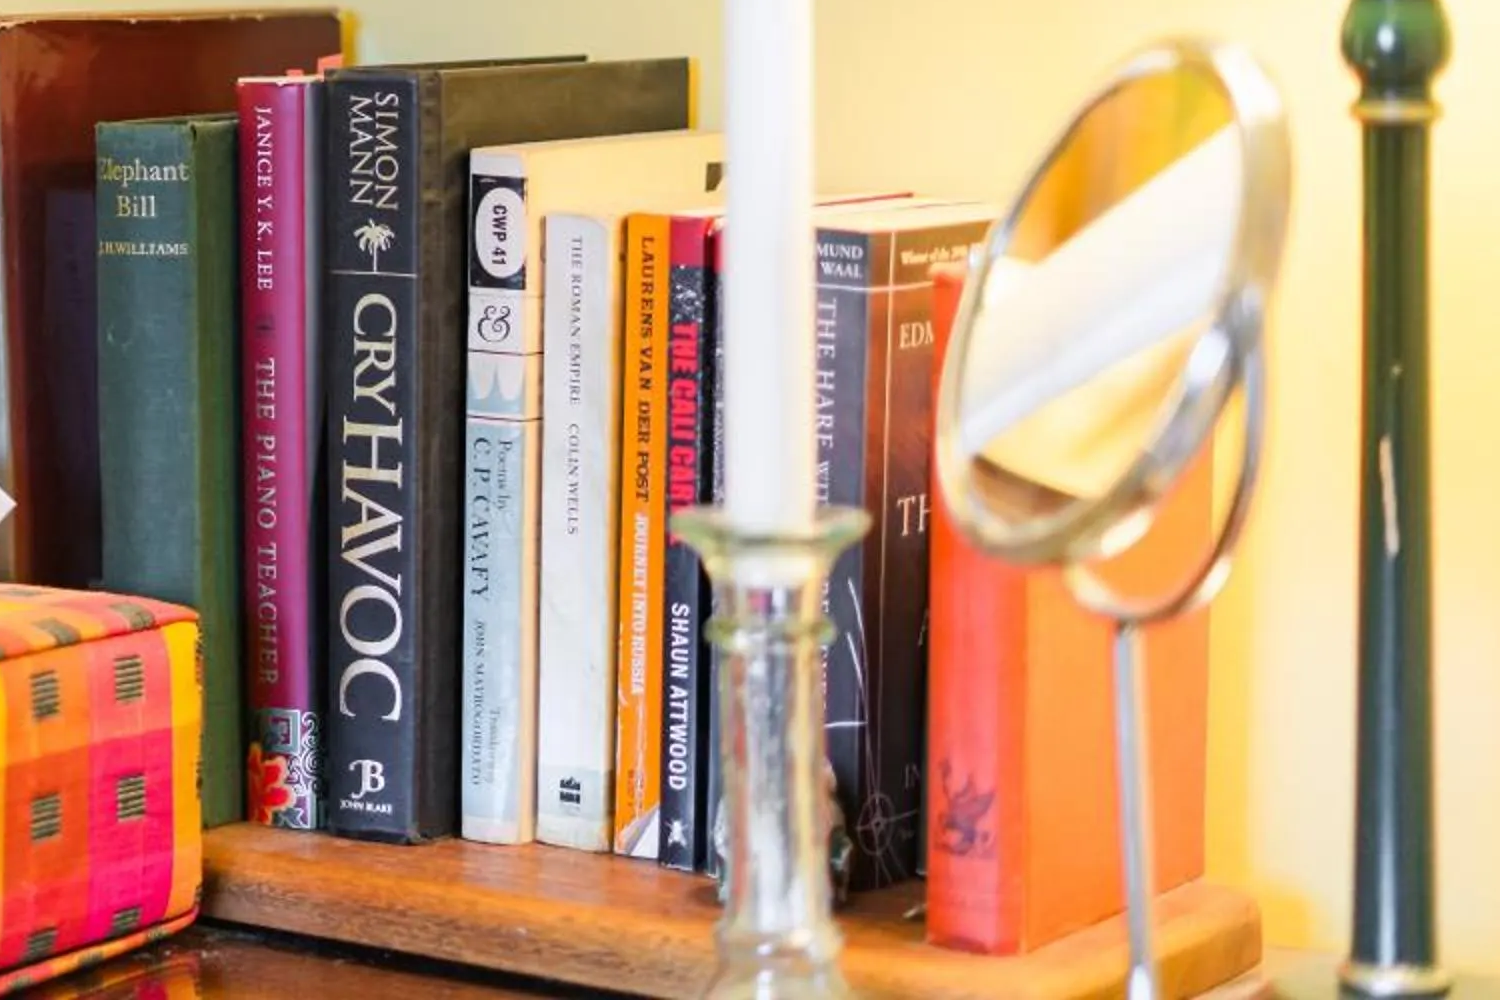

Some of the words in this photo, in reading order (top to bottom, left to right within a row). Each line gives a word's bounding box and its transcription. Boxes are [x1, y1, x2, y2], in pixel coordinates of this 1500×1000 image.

[100, 157, 189, 188] Elephant
[254, 107, 274, 187] JANICE
[350, 95, 373, 205] MANN
[375, 91, 399, 210] SIMON
[116, 194, 156, 217] Bill
[257, 196, 274, 214] Y.
[491, 205, 508, 242] CWP
[257, 221, 273, 241] K.
[491, 247, 507, 265] 41
[571, 236, 583, 269] THE
[256, 250, 274, 290] LEE
[640, 237, 655, 338] LAURENS
[821, 262, 863, 279] WAAL
[477, 305, 511, 343] &
[570, 277, 583, 336] ROMAN
[816, 298, 837, 358] THE
[352, 294, 398, 415] CRY
[637, 346, 653, 391] VAN
[672, 321, 698, 374] THE
[255, 358, 276, 420] THE
[568, 344, 582, 404] EMPIRE
[636, 401, 651, 448] DER
[671, 378, 697, 440] CALI
[815, 371, 835, 449] HARE
[472, 438, 492, 460] C.
[496, 439, 513, 489] Poems
[567, 423, 580, 473] COLIN
[256, 436, 277, 529] PIANO
[472, 467, 492, 487] P.
[494, 491, 513, 511] by
[634, 454, 650, 501] POST
[566, 480, 579, 535] WELLS
[339, 415, 403, 722] HAVOC
[470, 495, 491, 603] CAVAFY
[633, 513, 648, 586] JOURNEY
[255, 542, 278, 685] TEACHER
[473, 619, 486, 657] JOHN
[632, 593, 647, 633] INTO
[631, 636, 647, 695] RUSSIA
[670, 603, 690, 679] SHAUN
[668, 686, 688, 790] ATTWOOD
[340, 800, 363, 812] JOHN
[366, 801, 393, 815] BLAKE
